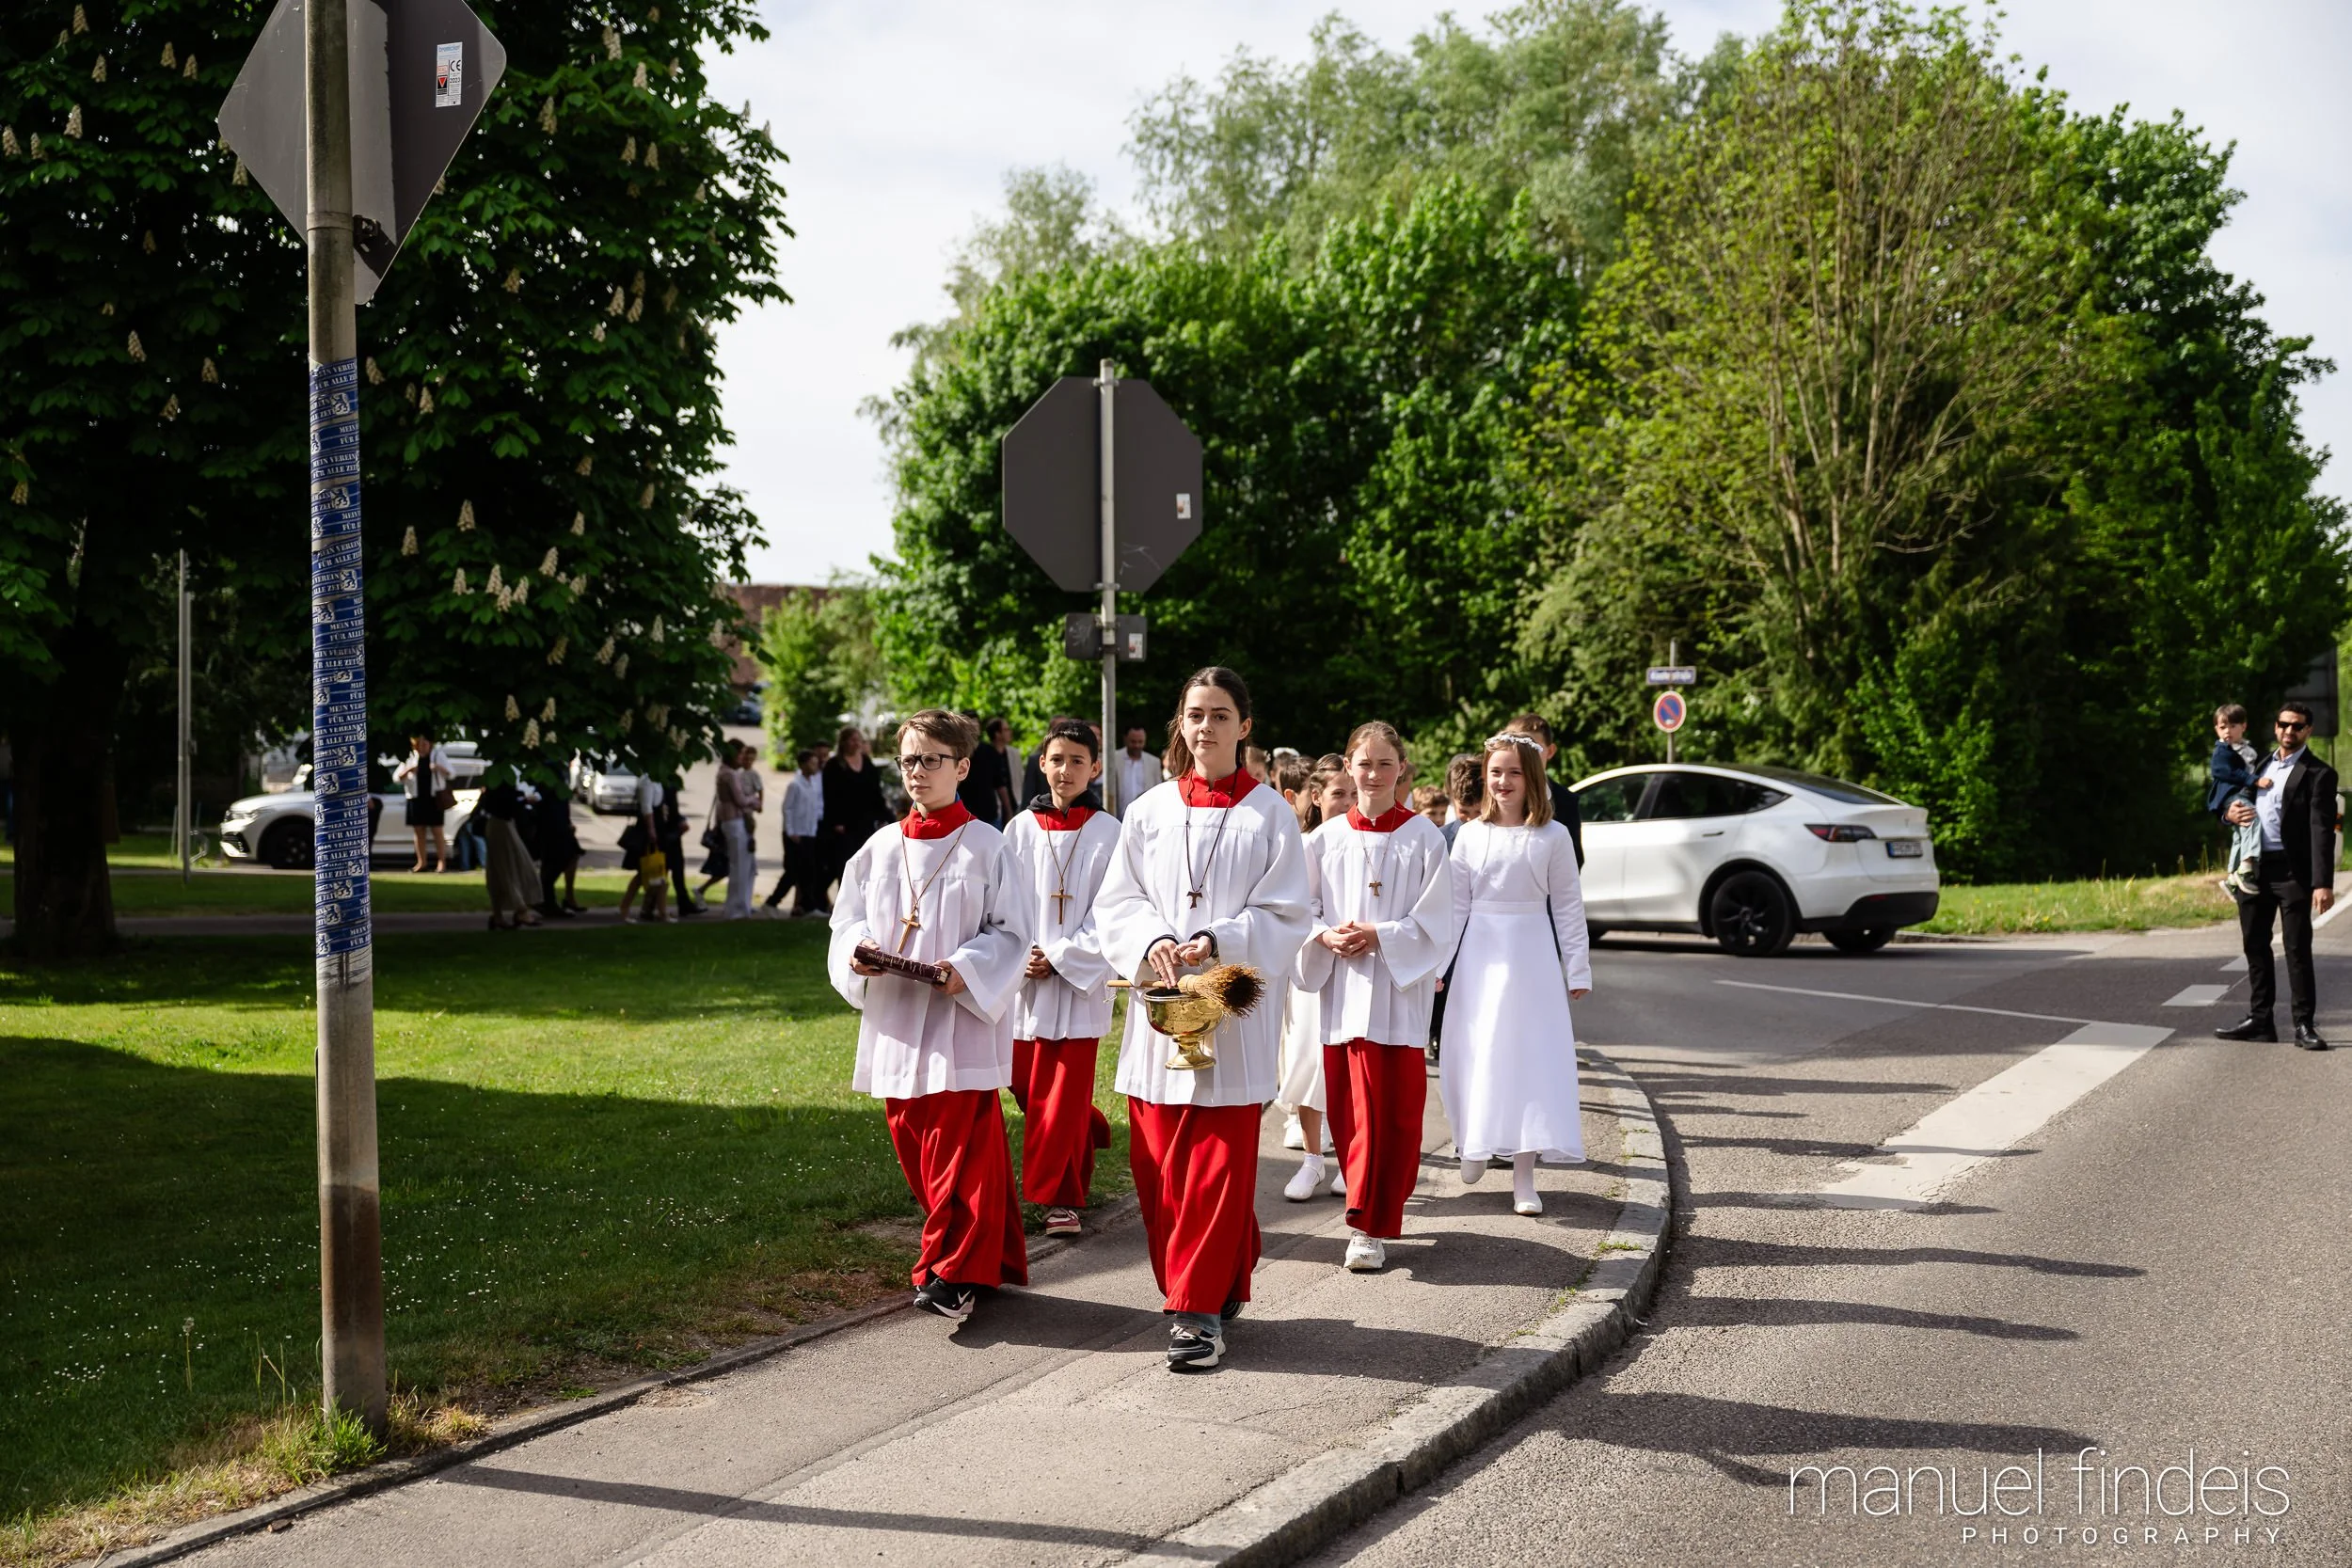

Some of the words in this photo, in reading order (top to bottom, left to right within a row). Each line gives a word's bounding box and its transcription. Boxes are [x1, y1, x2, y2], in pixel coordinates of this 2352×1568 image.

[450, 60, 461, 71] CE
[326, 466, 345, 474] ALLE
[335, 554, 352, 563] ALLE
[330, 621, 349, 630] MEIN
[330, 632, 346, 641] FÜR
[328, 716, 344, 724] FÜR
[326, 736, 342, 745] ALLE
[343, 799, 361, 807] MEIN
[343, 809, 358, 817] FÜR
